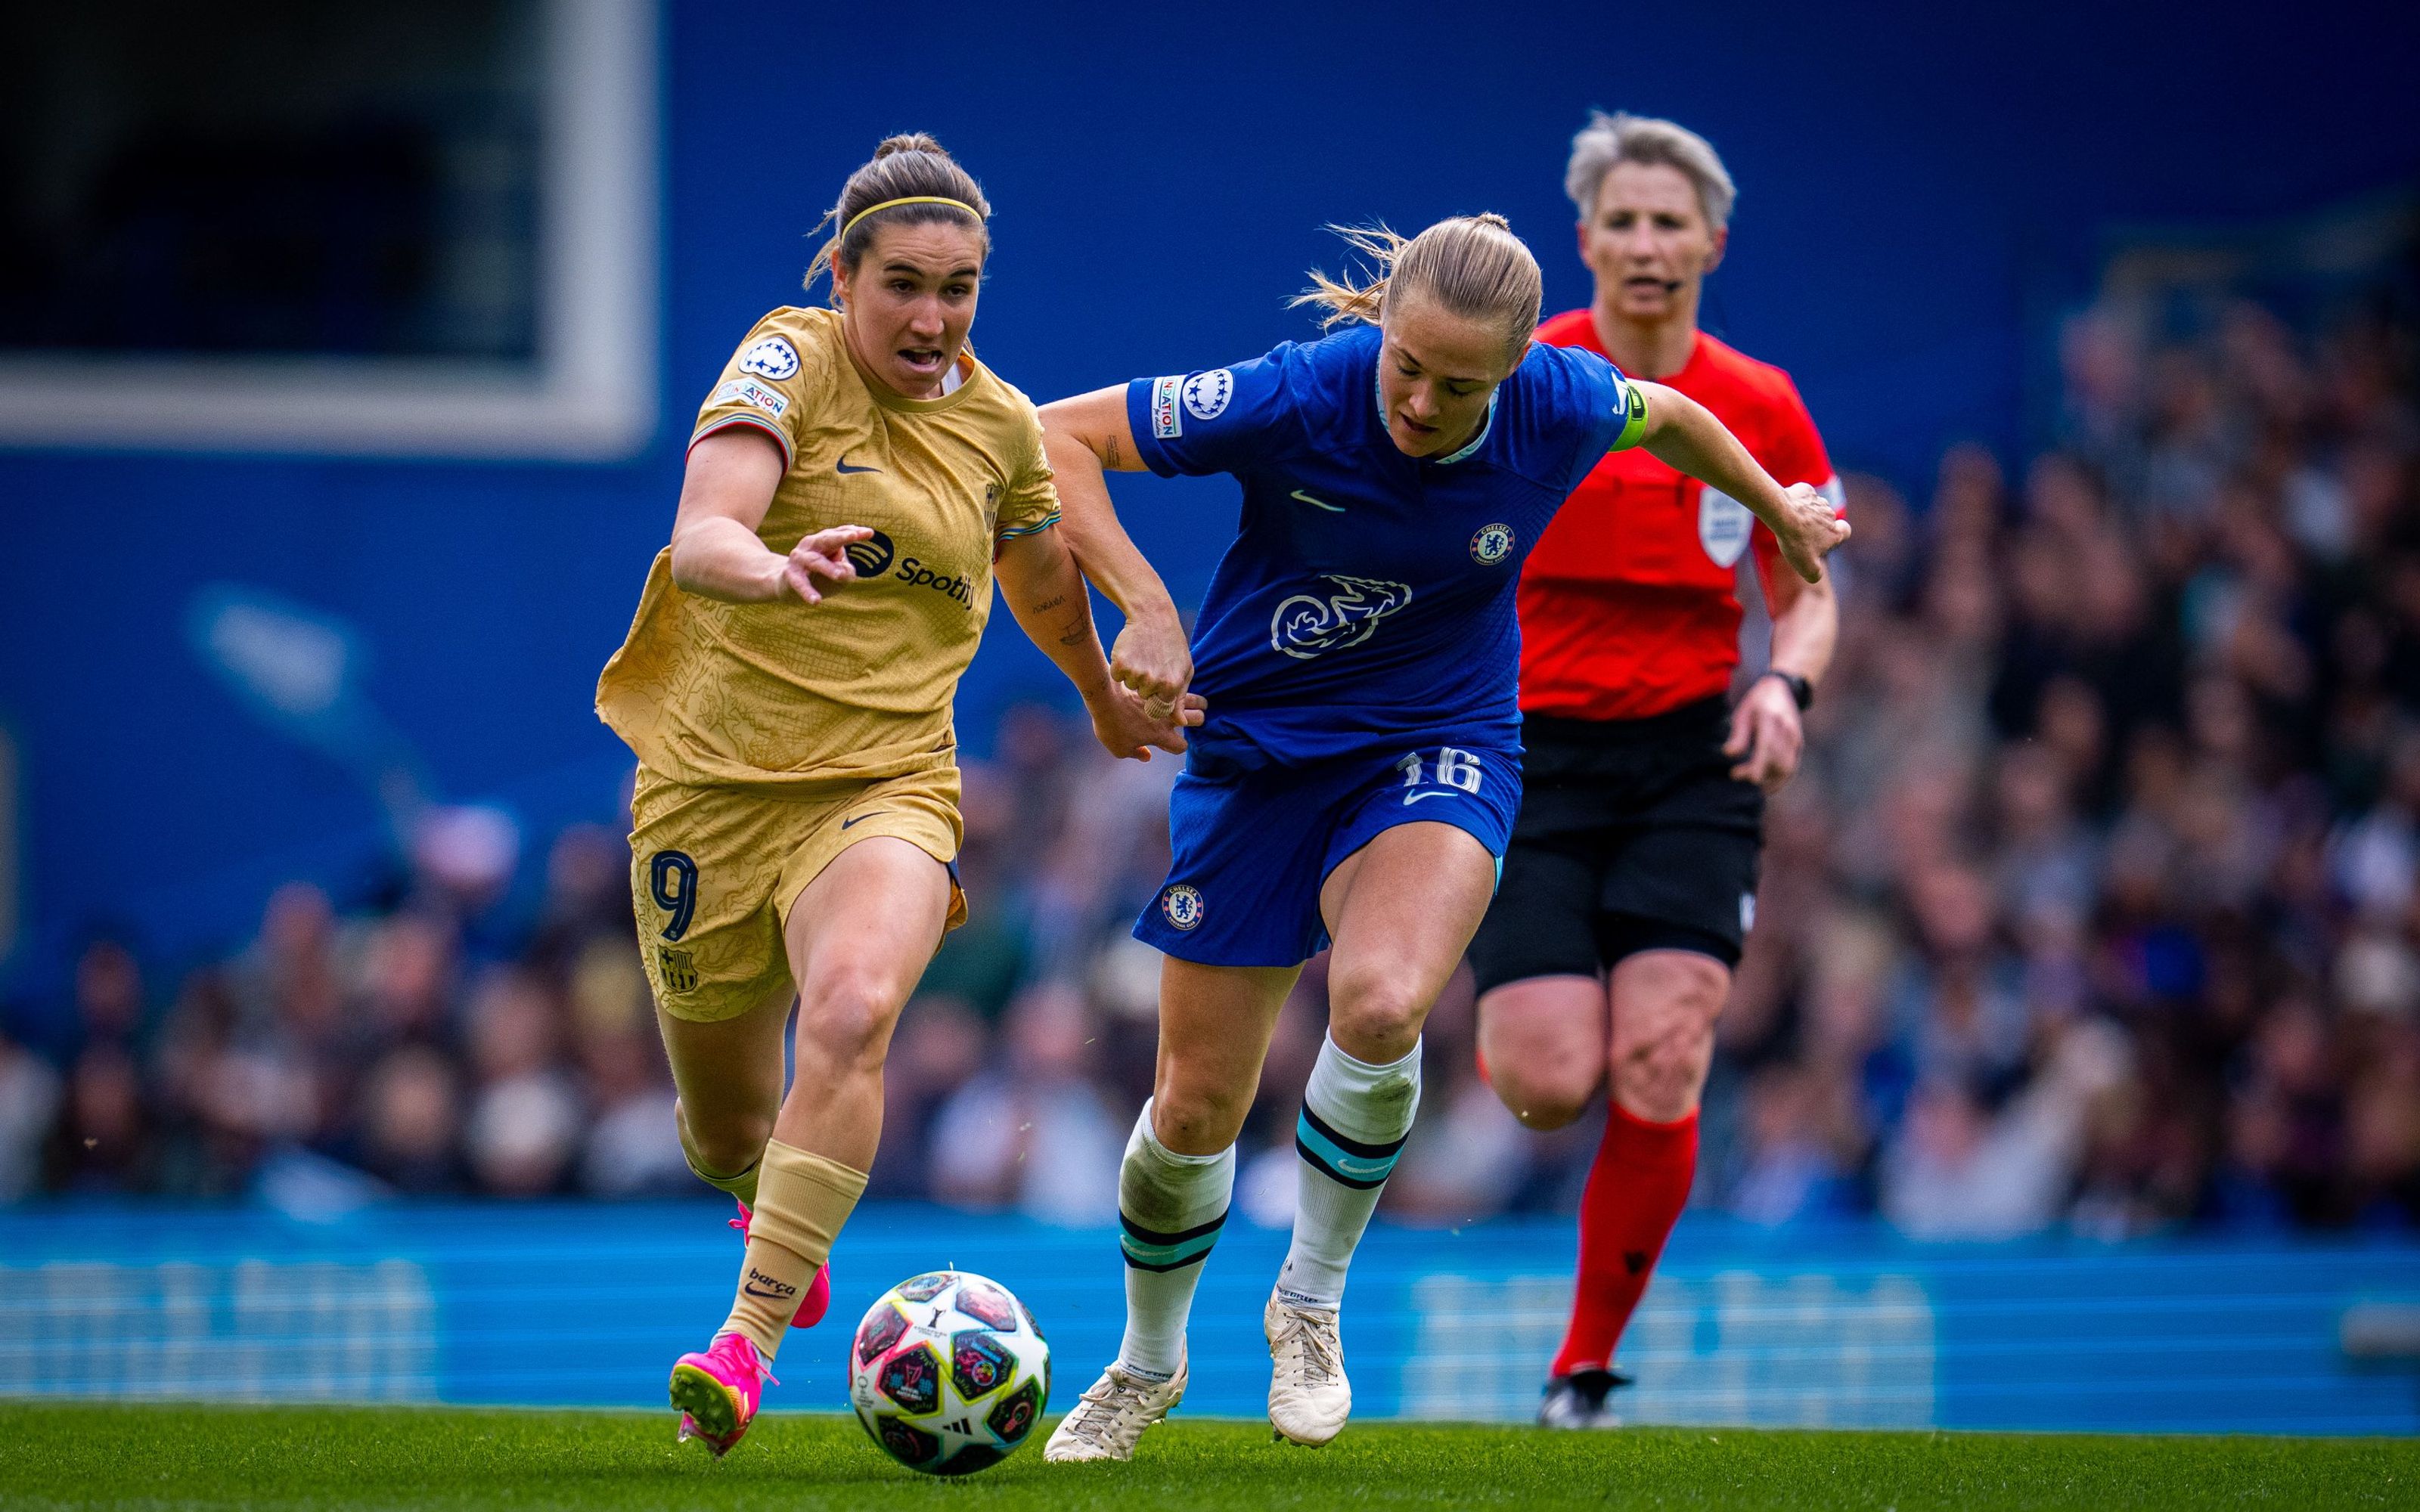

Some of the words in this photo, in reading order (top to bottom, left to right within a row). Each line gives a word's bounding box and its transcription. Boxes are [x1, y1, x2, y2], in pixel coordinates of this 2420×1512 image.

[1481, 525, 1509, 535] CHELSEA
[895, 557, 974, 610] Spotify
[1395, 746, 1482, 795] 16
[651, 850, 699, 943] 9
[1169, 886, 1197, 897] CHELSEA
[749, 1267, 796, 1295] barça
